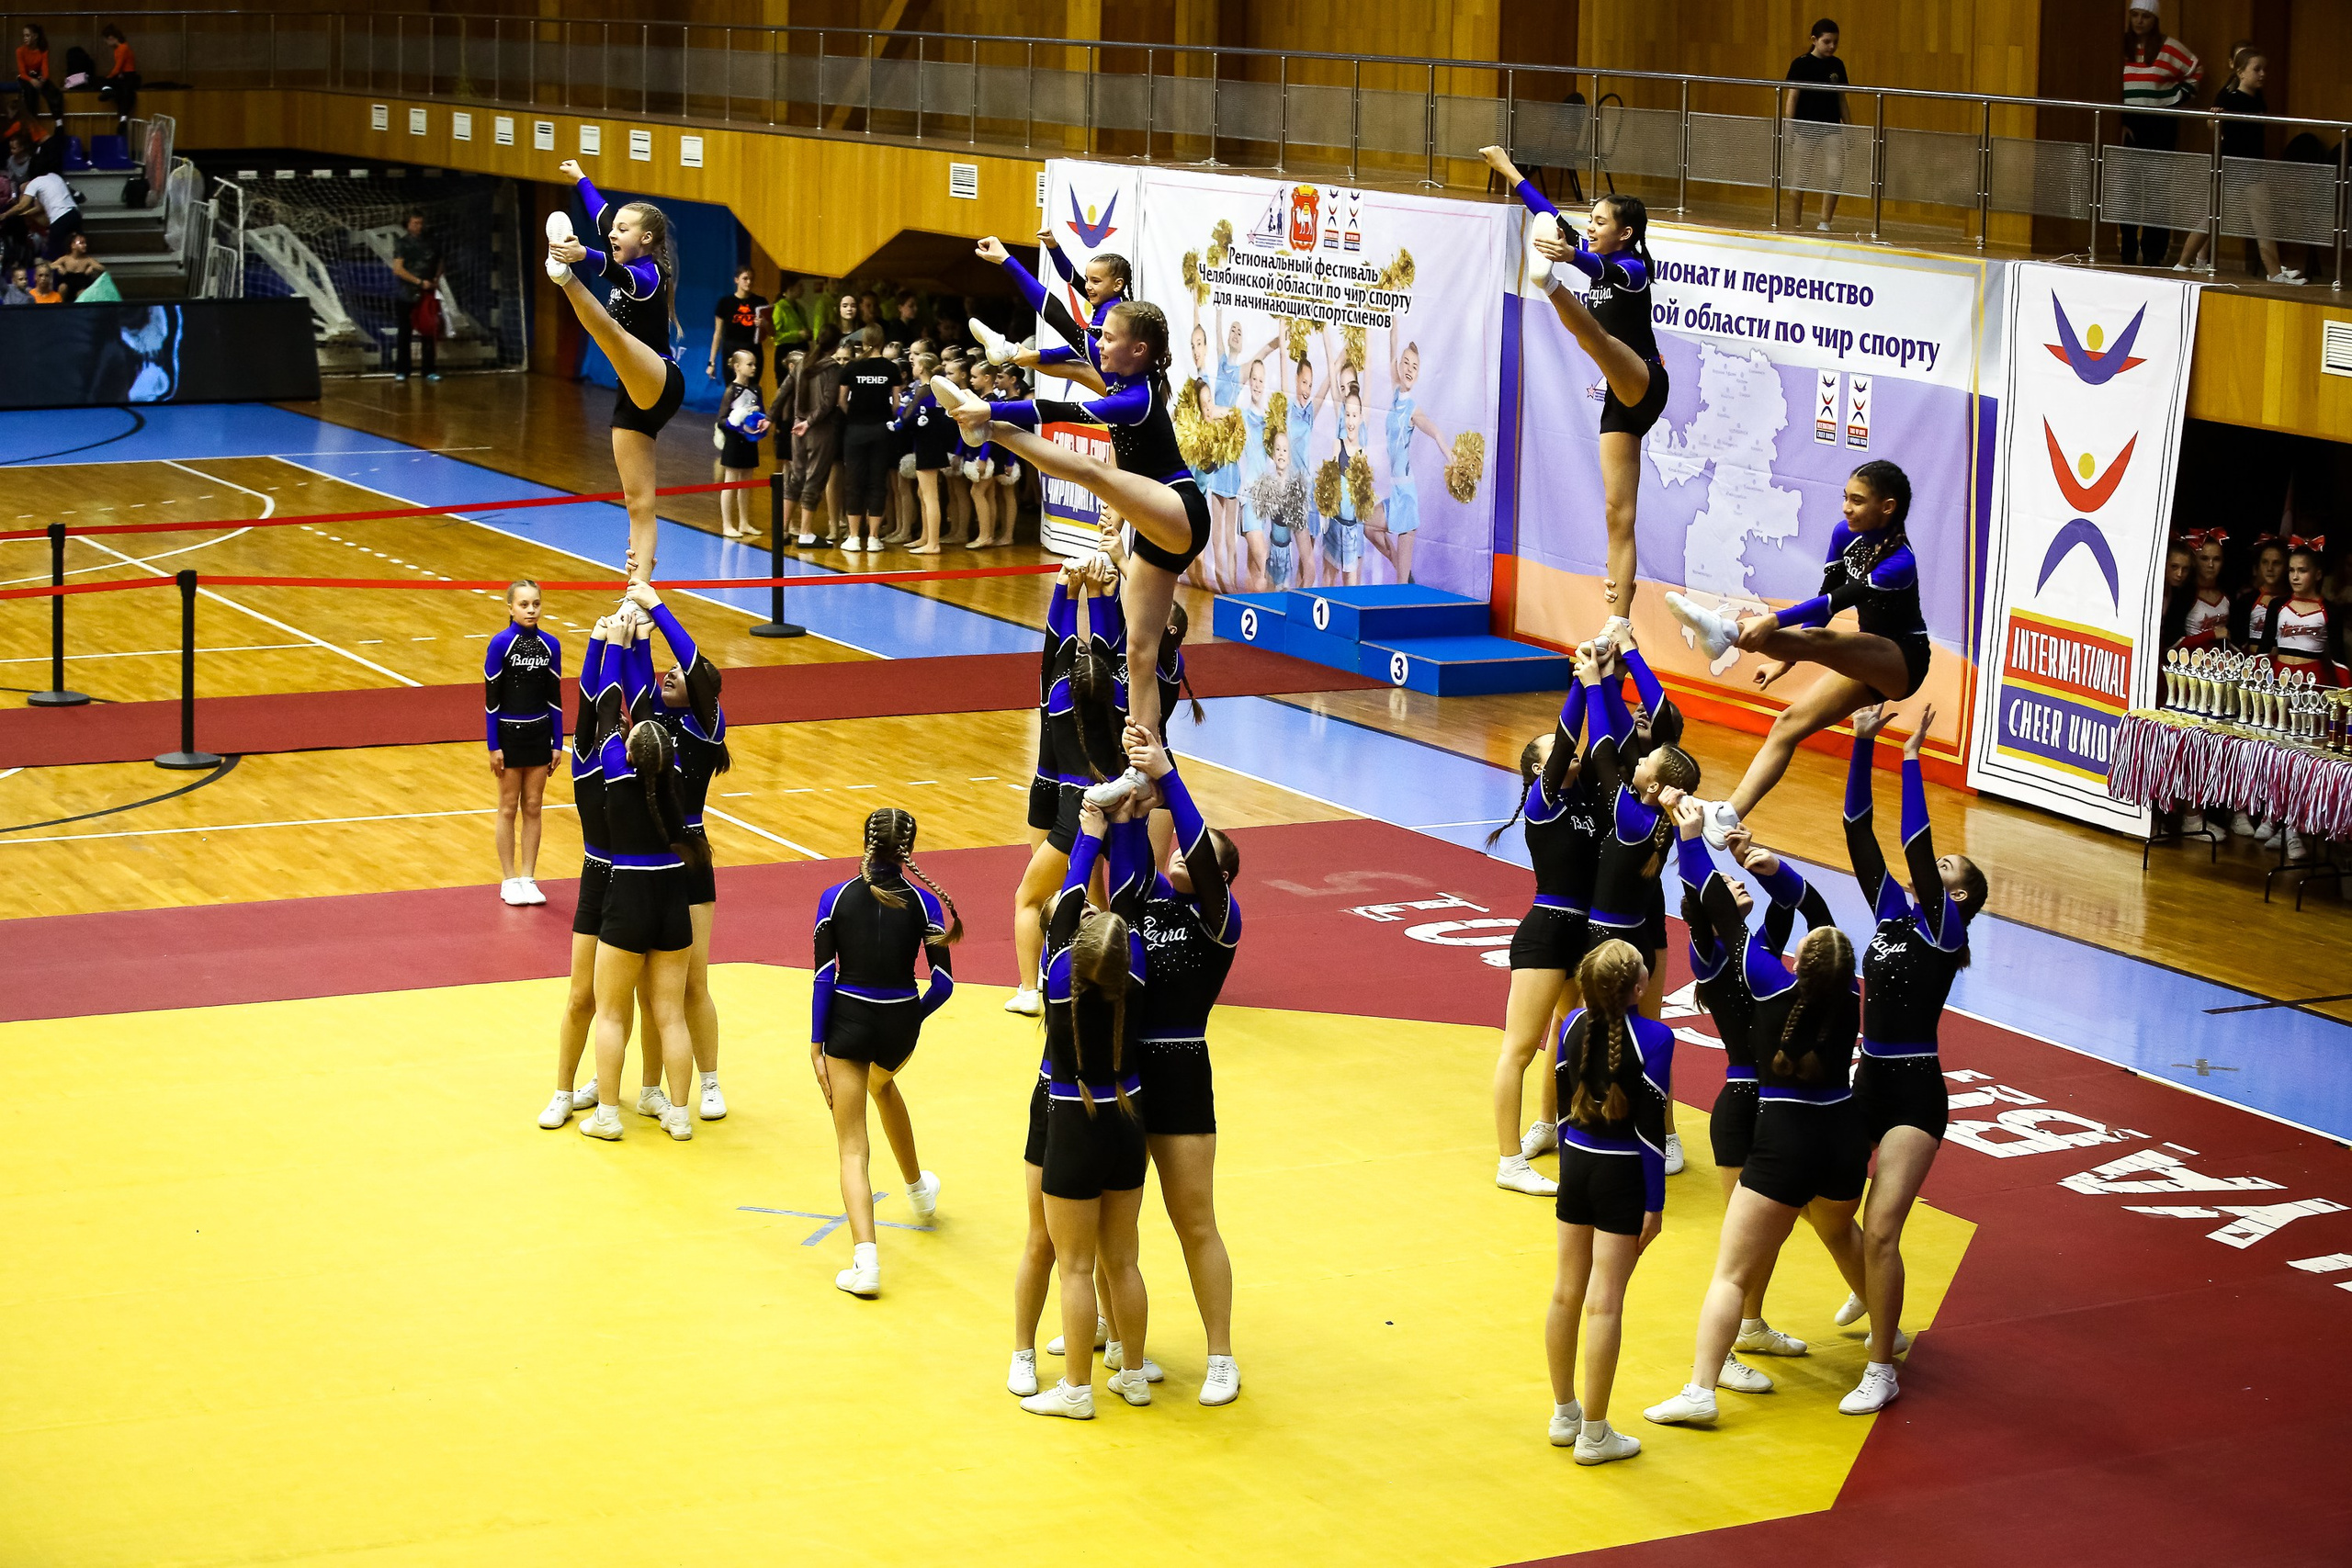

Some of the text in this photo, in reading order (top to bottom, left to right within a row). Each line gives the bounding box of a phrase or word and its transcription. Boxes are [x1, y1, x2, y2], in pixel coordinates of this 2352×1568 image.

[1228, 246, 1378, 282] Региональный фестиваль
[1199, 263, 1412, 314] Челябинской области по чир спорту
[1654, 259, 1874, 308] ионат и первенство
[1214, 290, 1391, 328] для начинающих спортсменов
[1684, 302, 1770, 339] области
[1774, 321, 1806, 344] по
[1812, 325, 1853, 359] чир
[1859, 333, 1940, 372] спорту
[855, 375, 888, 384] ТРЕНЕР
[1244, 614, 1254, 636] 2
[1317, 603, 1324, 626] 1
[510, 653, 549, 671] Bagira
[1394, 657, 1404, 681] 3
[2011, 626, 2127, 699] INTERNATIONAL
[2007, 698, 2064, 750] CHEER
